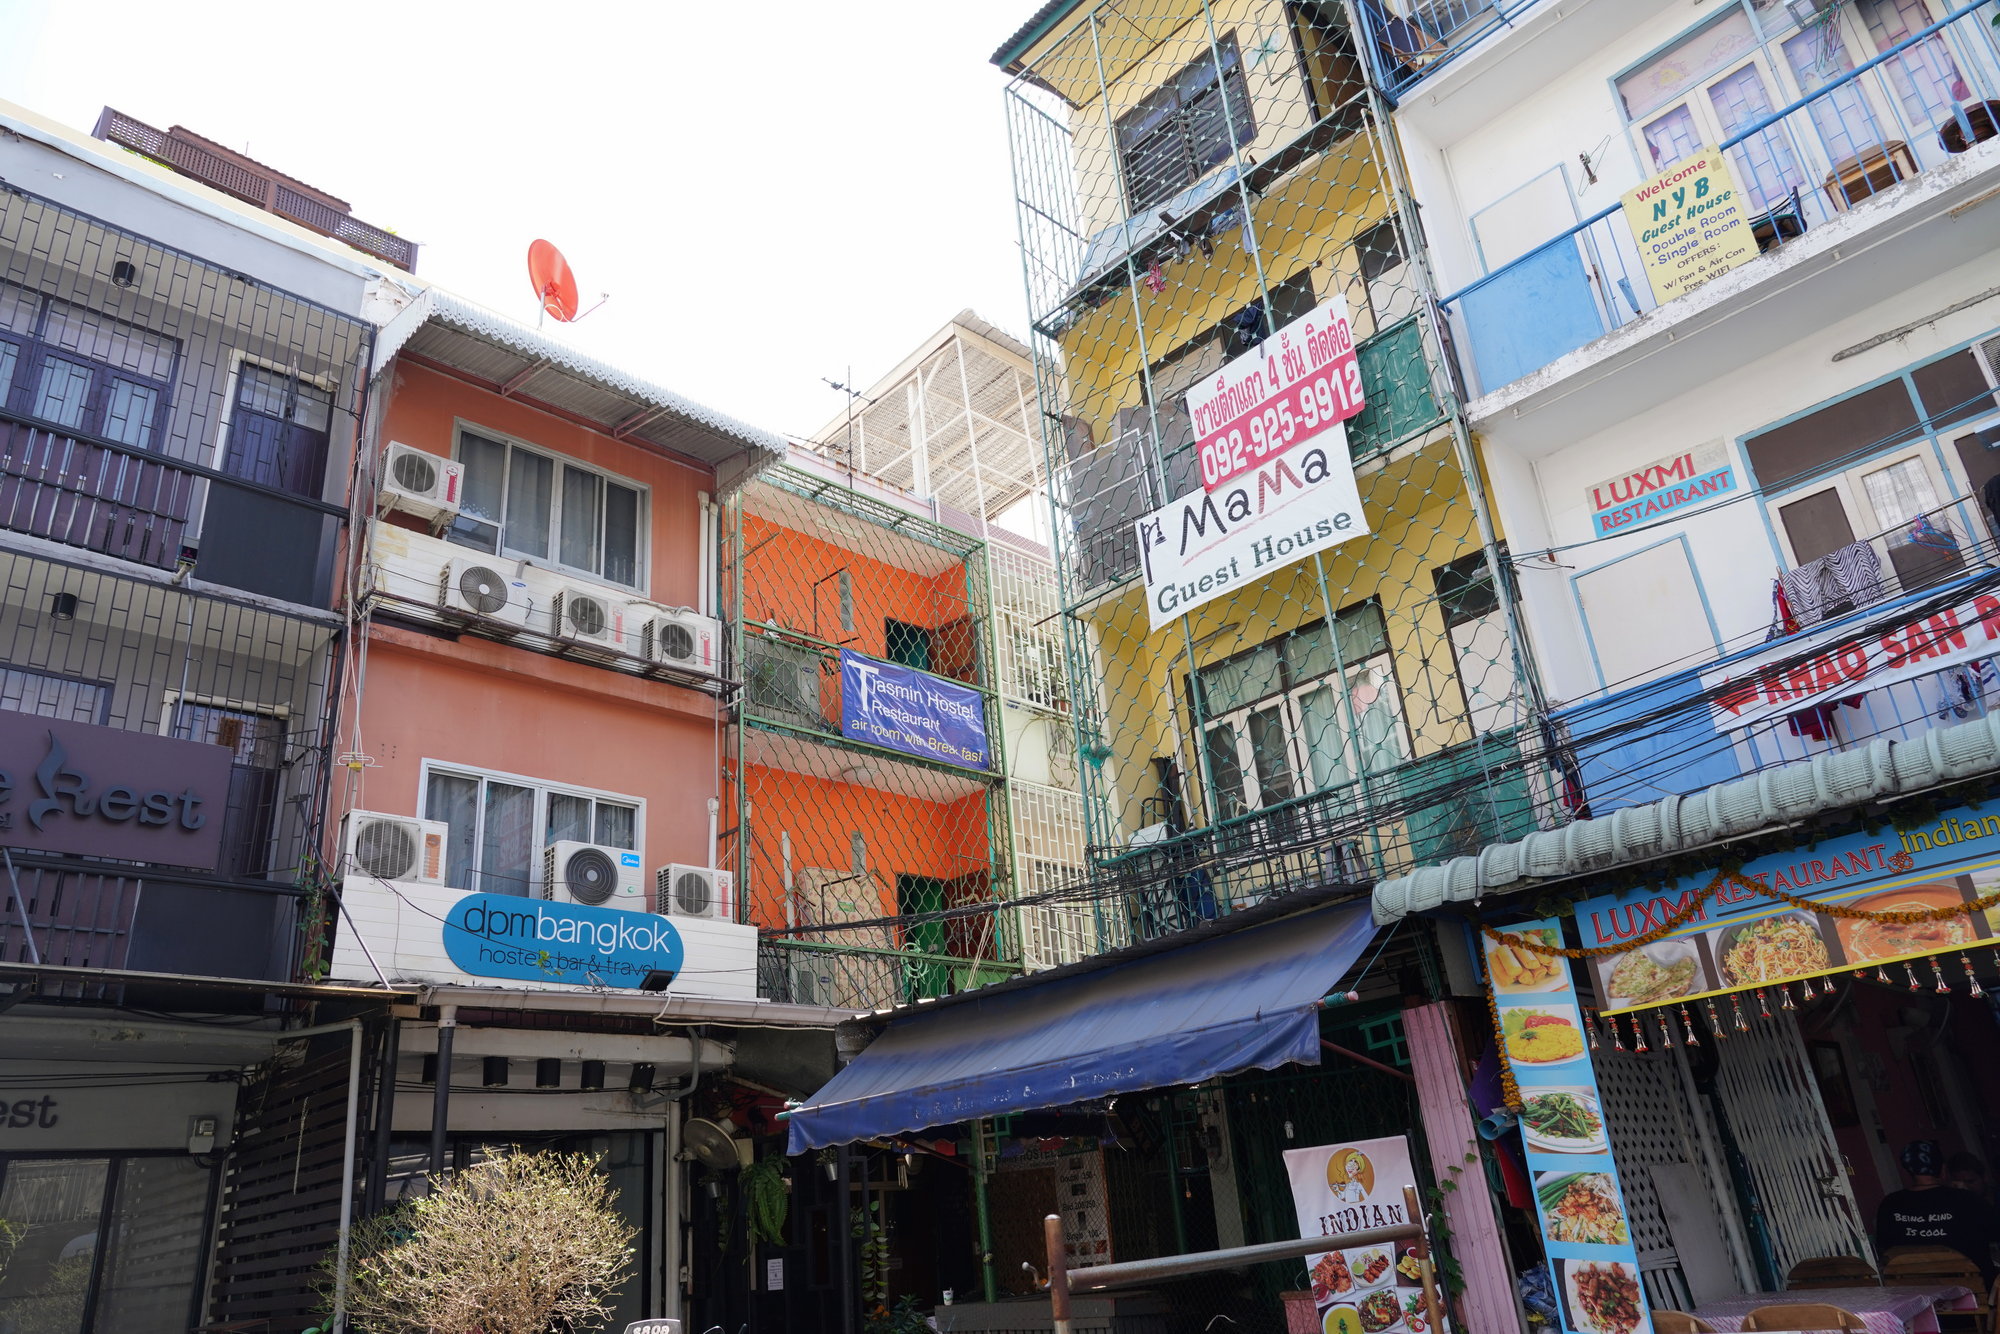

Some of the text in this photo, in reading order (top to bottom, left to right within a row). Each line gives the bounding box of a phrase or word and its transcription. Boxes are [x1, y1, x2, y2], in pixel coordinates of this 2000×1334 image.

[1636, 160, 1707, 202] Welcome
[1653, 199, 1667, 221] N
[1694, 176, 1710, 199] B
[1642, 190, 1731, 243] Guest House
[1652, 206, 1737, 254] Double Room
[1658, 218, 1740, 265] Single Room
[1698, 265, 1706, 273] &
[1709, 257, 1724, 268] Air
[1725, 247, 1746, 259] Con
[1683, 265, 1730, 291] Free WIFI
[1194, 308, 1351, 436] ขายตึกแถว 4 ชั้น ติดต่อ
[1201, 360, 1364, 485] 092-925-9912
[1180, 448, 1331, 556] MaMa
[1592, 453, 1697, 511] LUXMI
[1600, 471, 1729, 532] RESTAURANT
[1157, 512, 1353, 613] Guest House
[1757, 640, 1868, 706] KHAO
[1880, 608, 1968, 669] SAN
[872, 700, 940, 730] Restaurant
[927, 692, 975, 719] Hostel
[852, 718, 868, 731] air
[871, 725, 900, 741] room
[961, 747, 983, 763] fast
[28, 729, 207, 832] Rest
[1898, 814, 2000, 855] indian
[1591, 843, 1887, 943] LUXMI RESTAURANT
[464, 900, 671, 954] dpmbangkok
[557, 951, 585, 971] bar
[588, 954, 601, 973] &
[606, 955, 657, 977] travel
[1319, 1204, 1403, 1236] INDIAN
[1929, 1213, 1953, 1222] KIND
